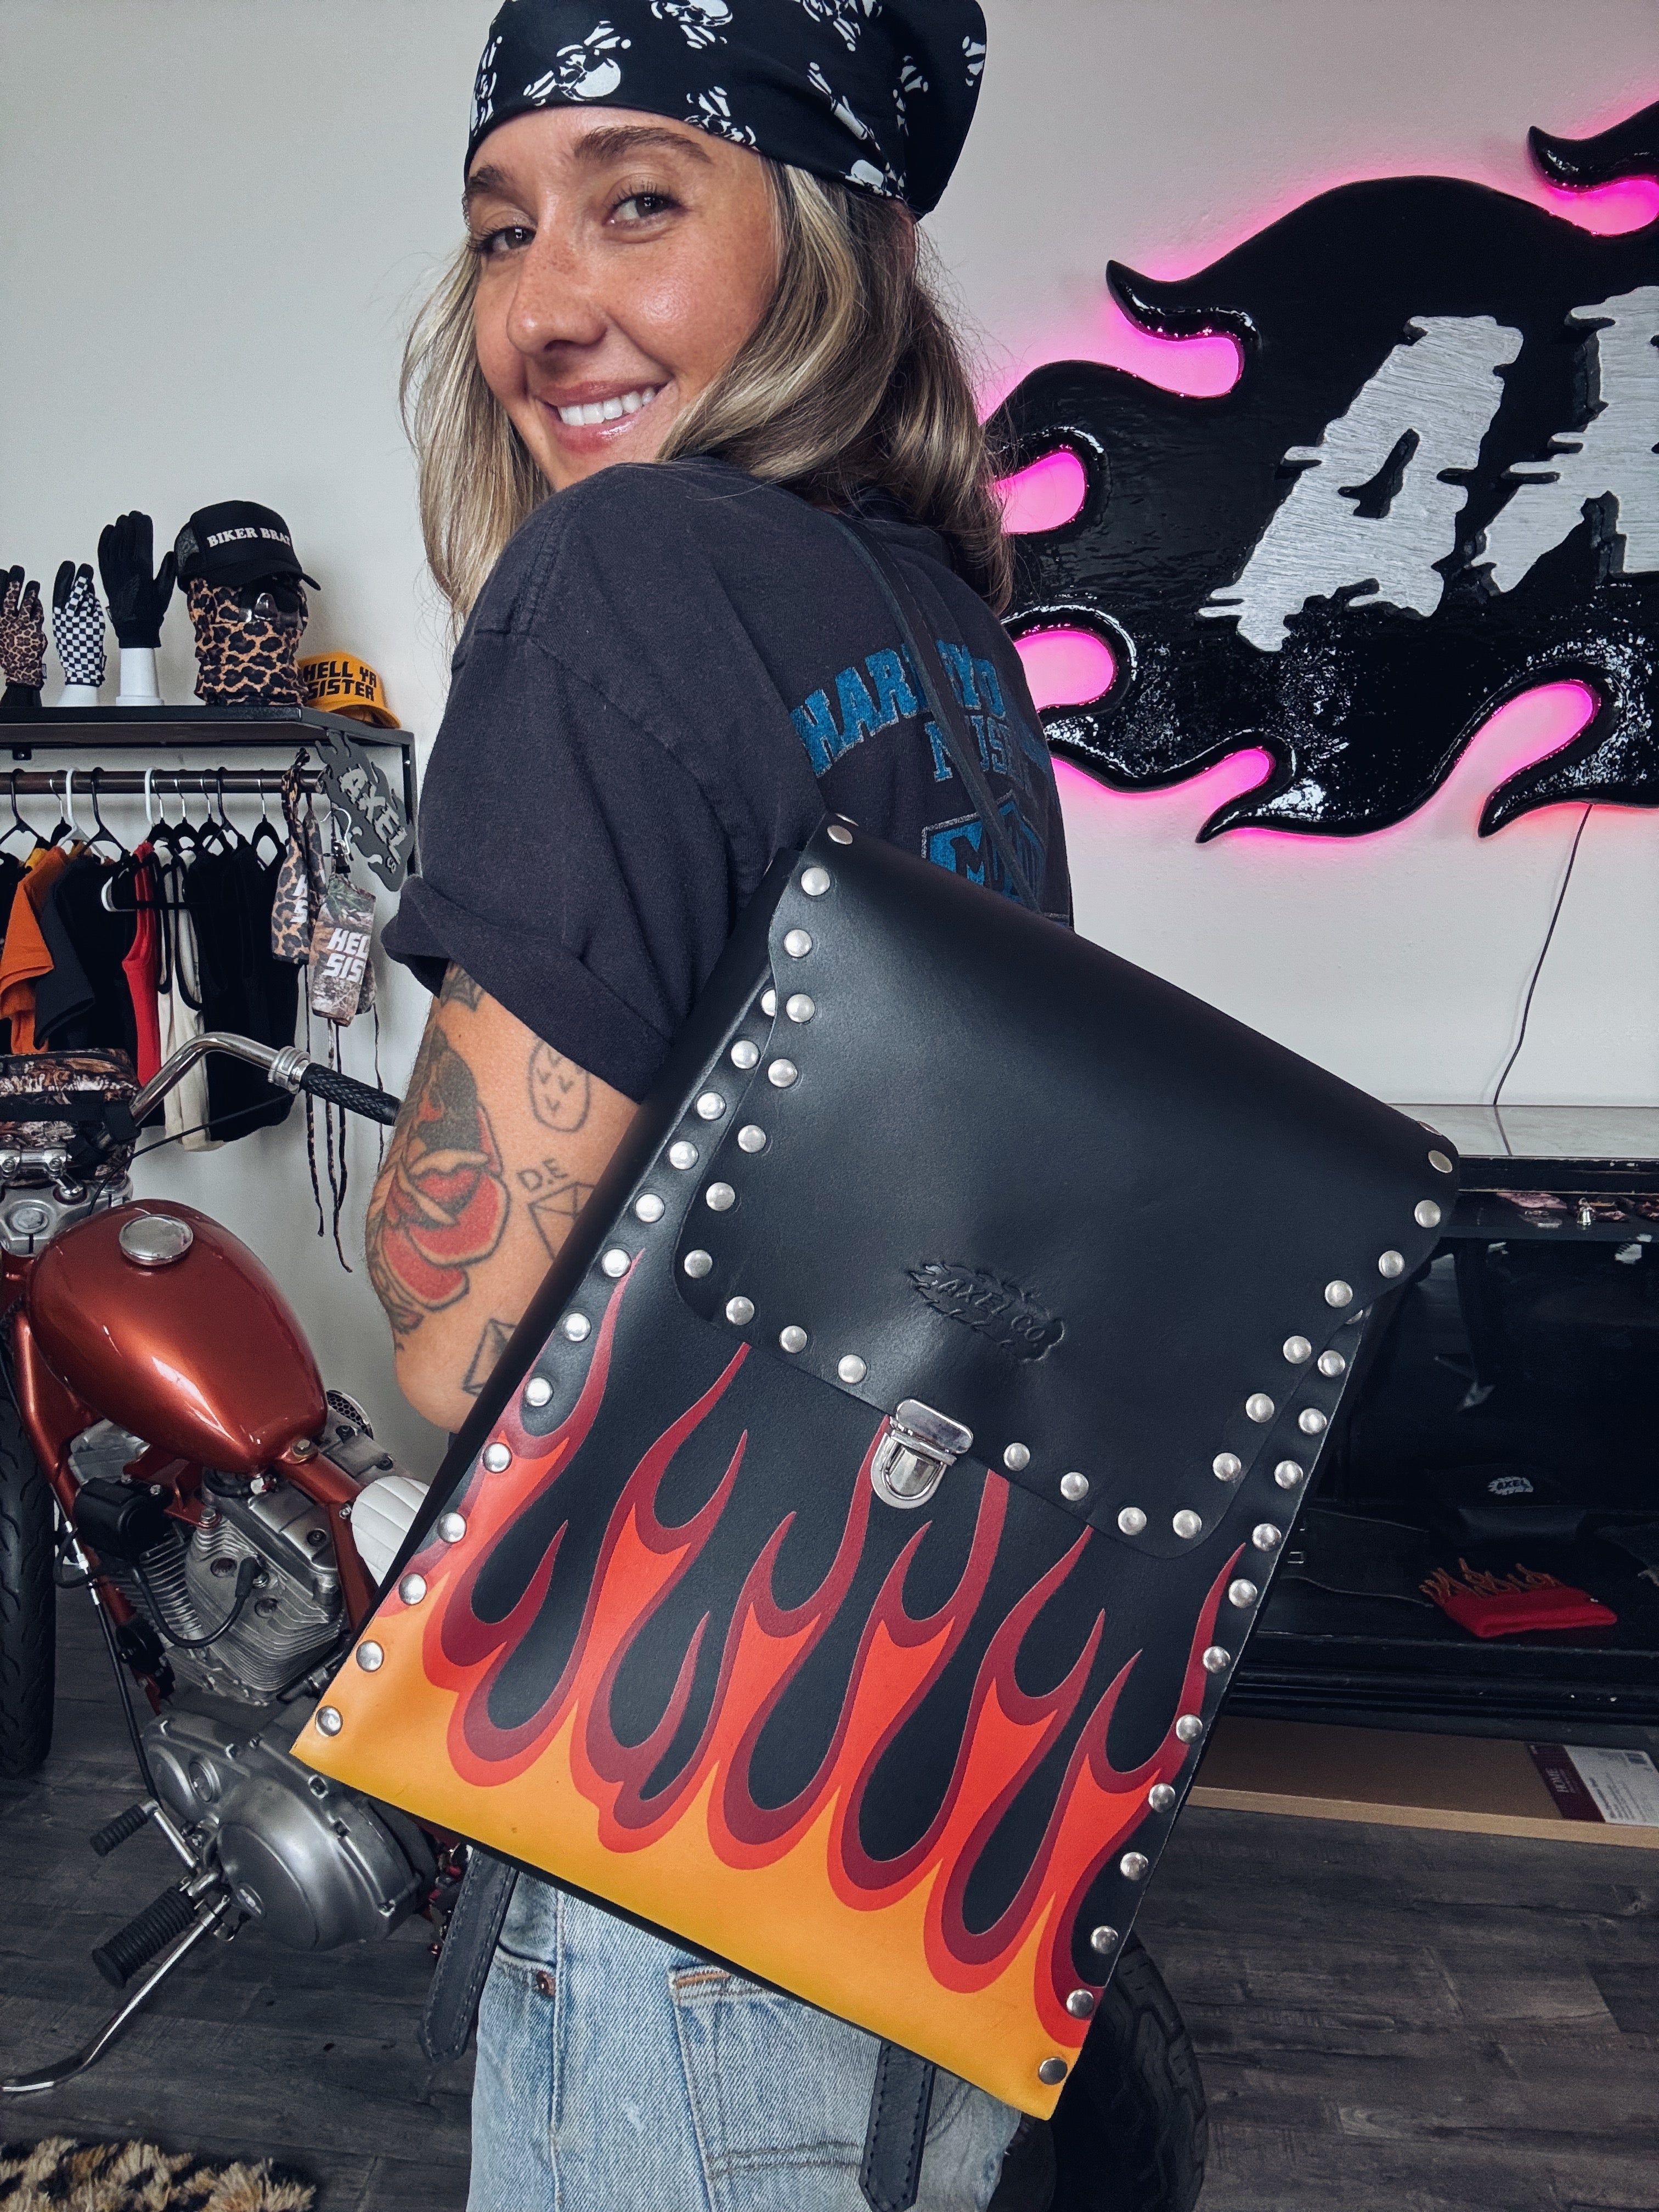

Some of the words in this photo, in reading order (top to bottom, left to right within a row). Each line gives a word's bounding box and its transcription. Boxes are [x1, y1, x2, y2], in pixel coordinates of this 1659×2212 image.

[206, 527, 259, 548] BIKER
[259, 527, 291, 546] BRAT
[303, 661, 353, 682] HELL
[359, 666, 377, 688] YA
[307, 679, 375, 702] SISTER
[338, 764, 408, 865] AXEL
[937, 1278, 1016, 1321] AXEL
